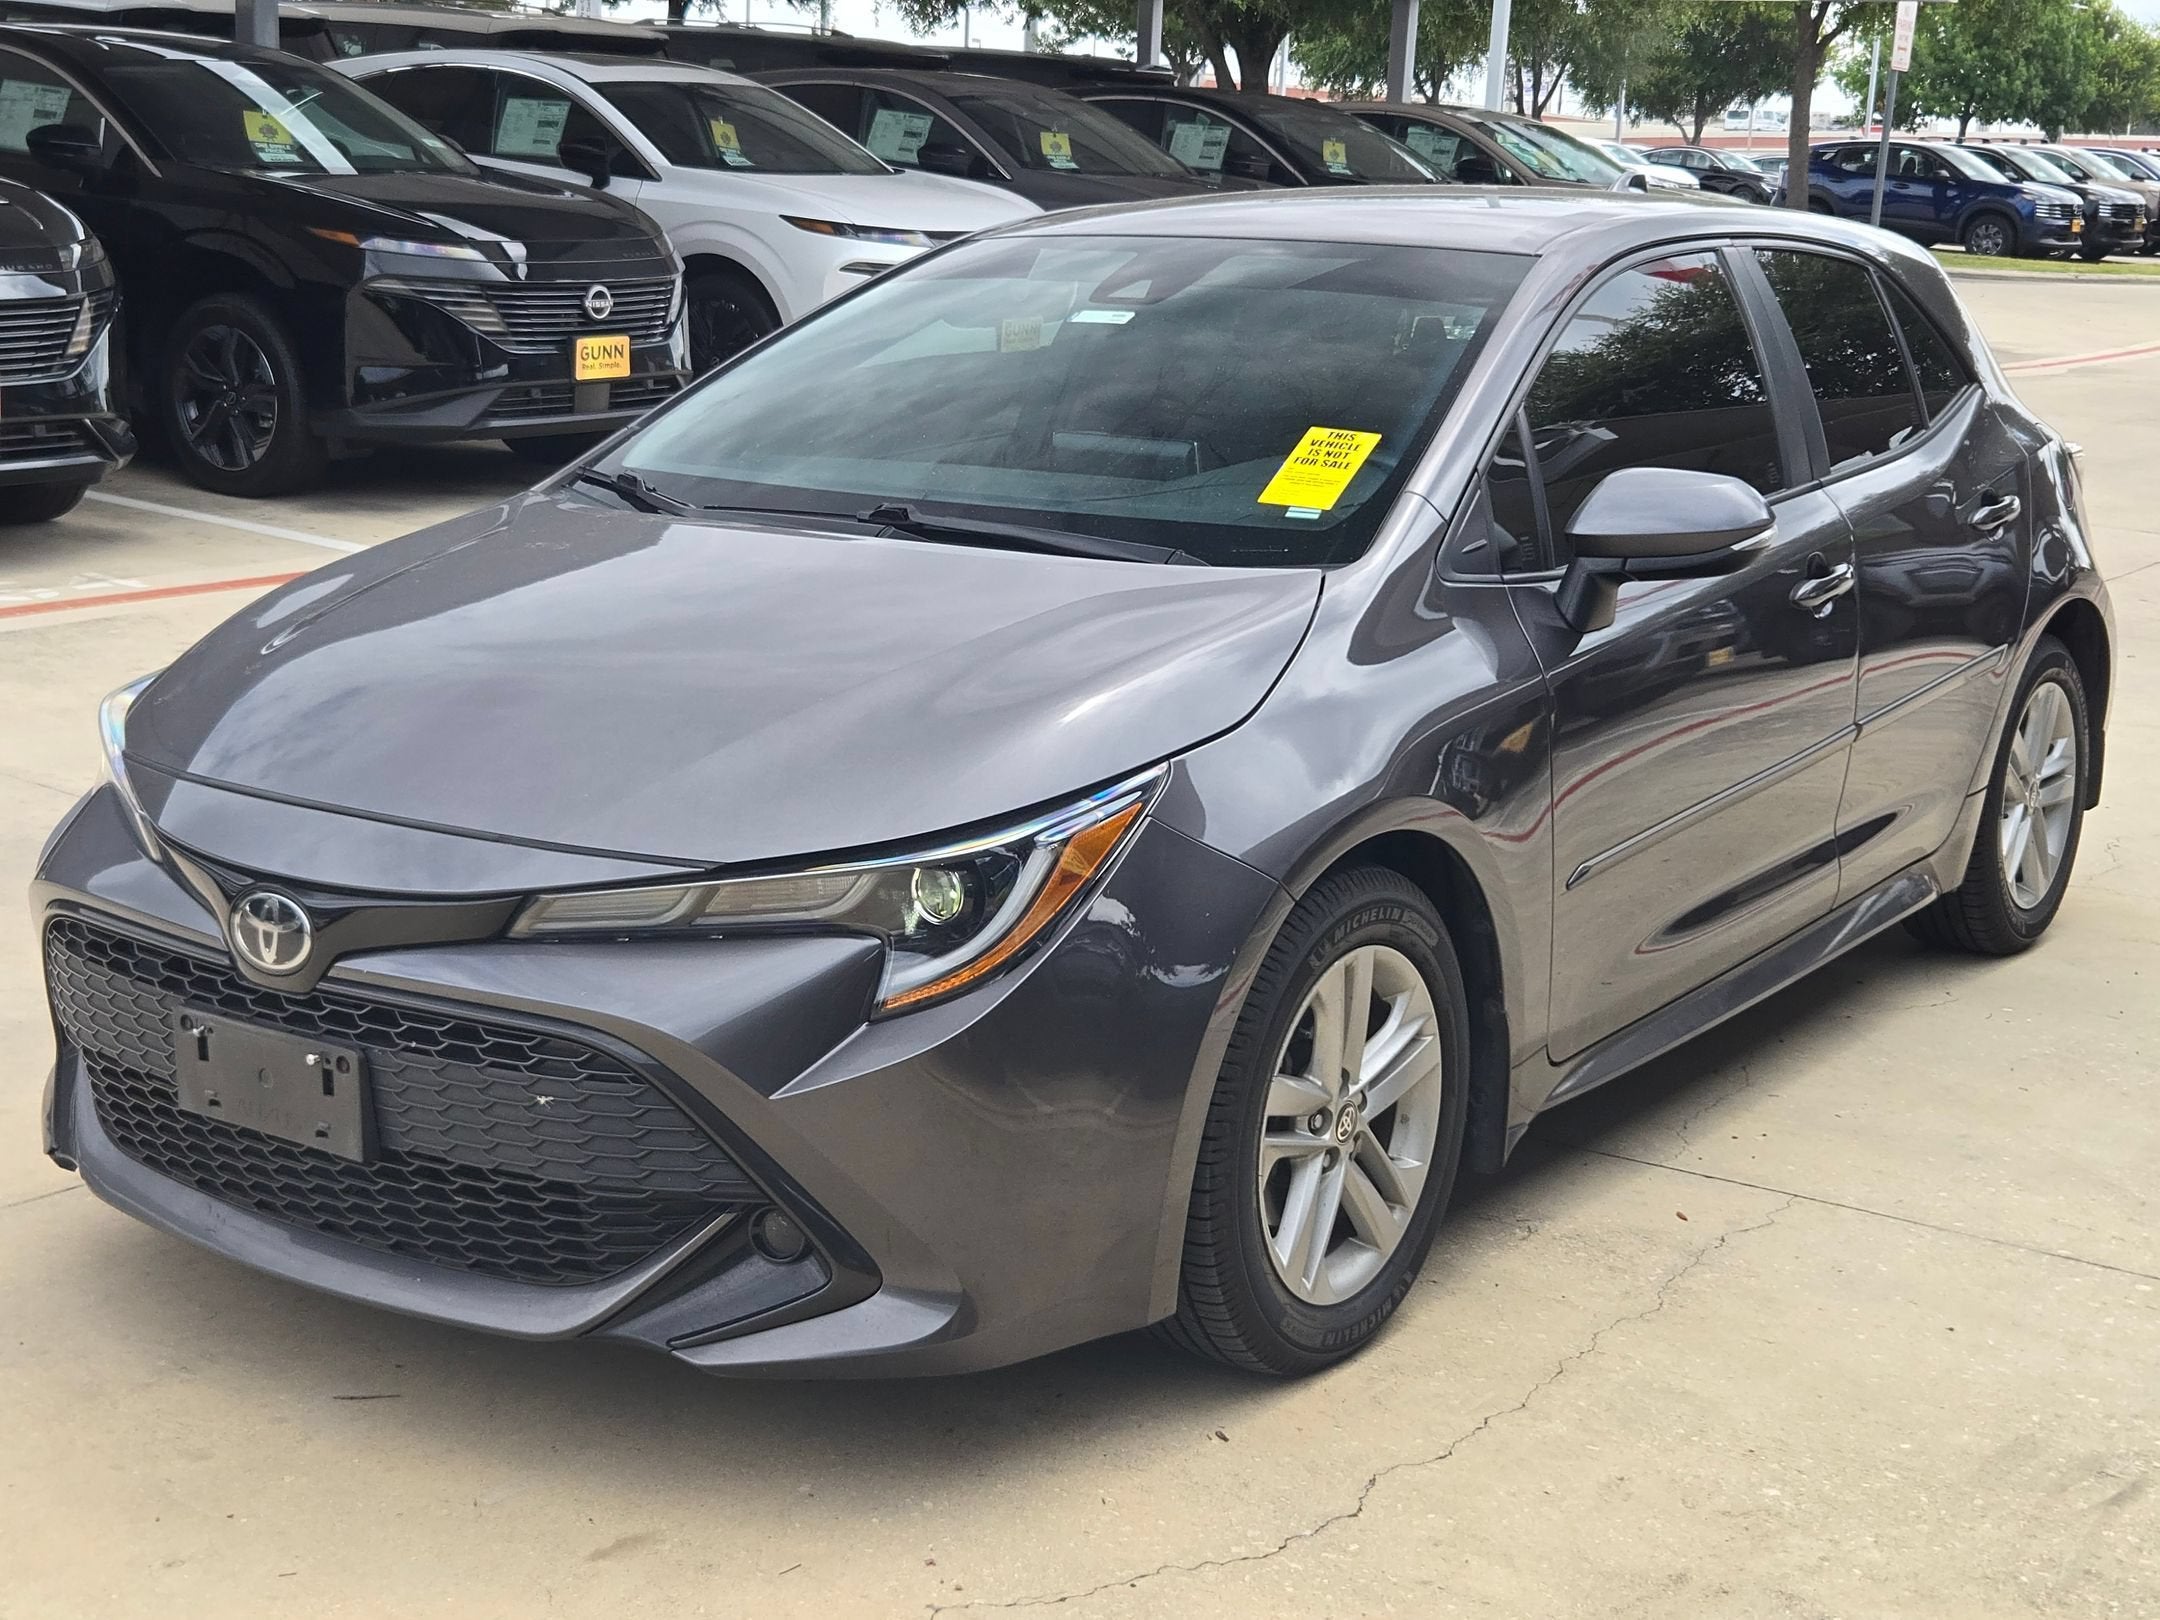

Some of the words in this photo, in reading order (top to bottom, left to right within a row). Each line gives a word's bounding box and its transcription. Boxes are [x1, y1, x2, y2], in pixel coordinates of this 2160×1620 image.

[580, 344, 624, 361] GUNN
[1327, 431, 1357, 441] THIS
[1310, 439, 1361, 452] VEHICLE
[1308, 448, 1320, 457] IS
[1323, 449, 1350, 460] NOT
[1293, 456, 1318, 466] FOR
[1320, 459, 1351, 470] SALE
[1334, 906, 1402, 943] MICHELIN
